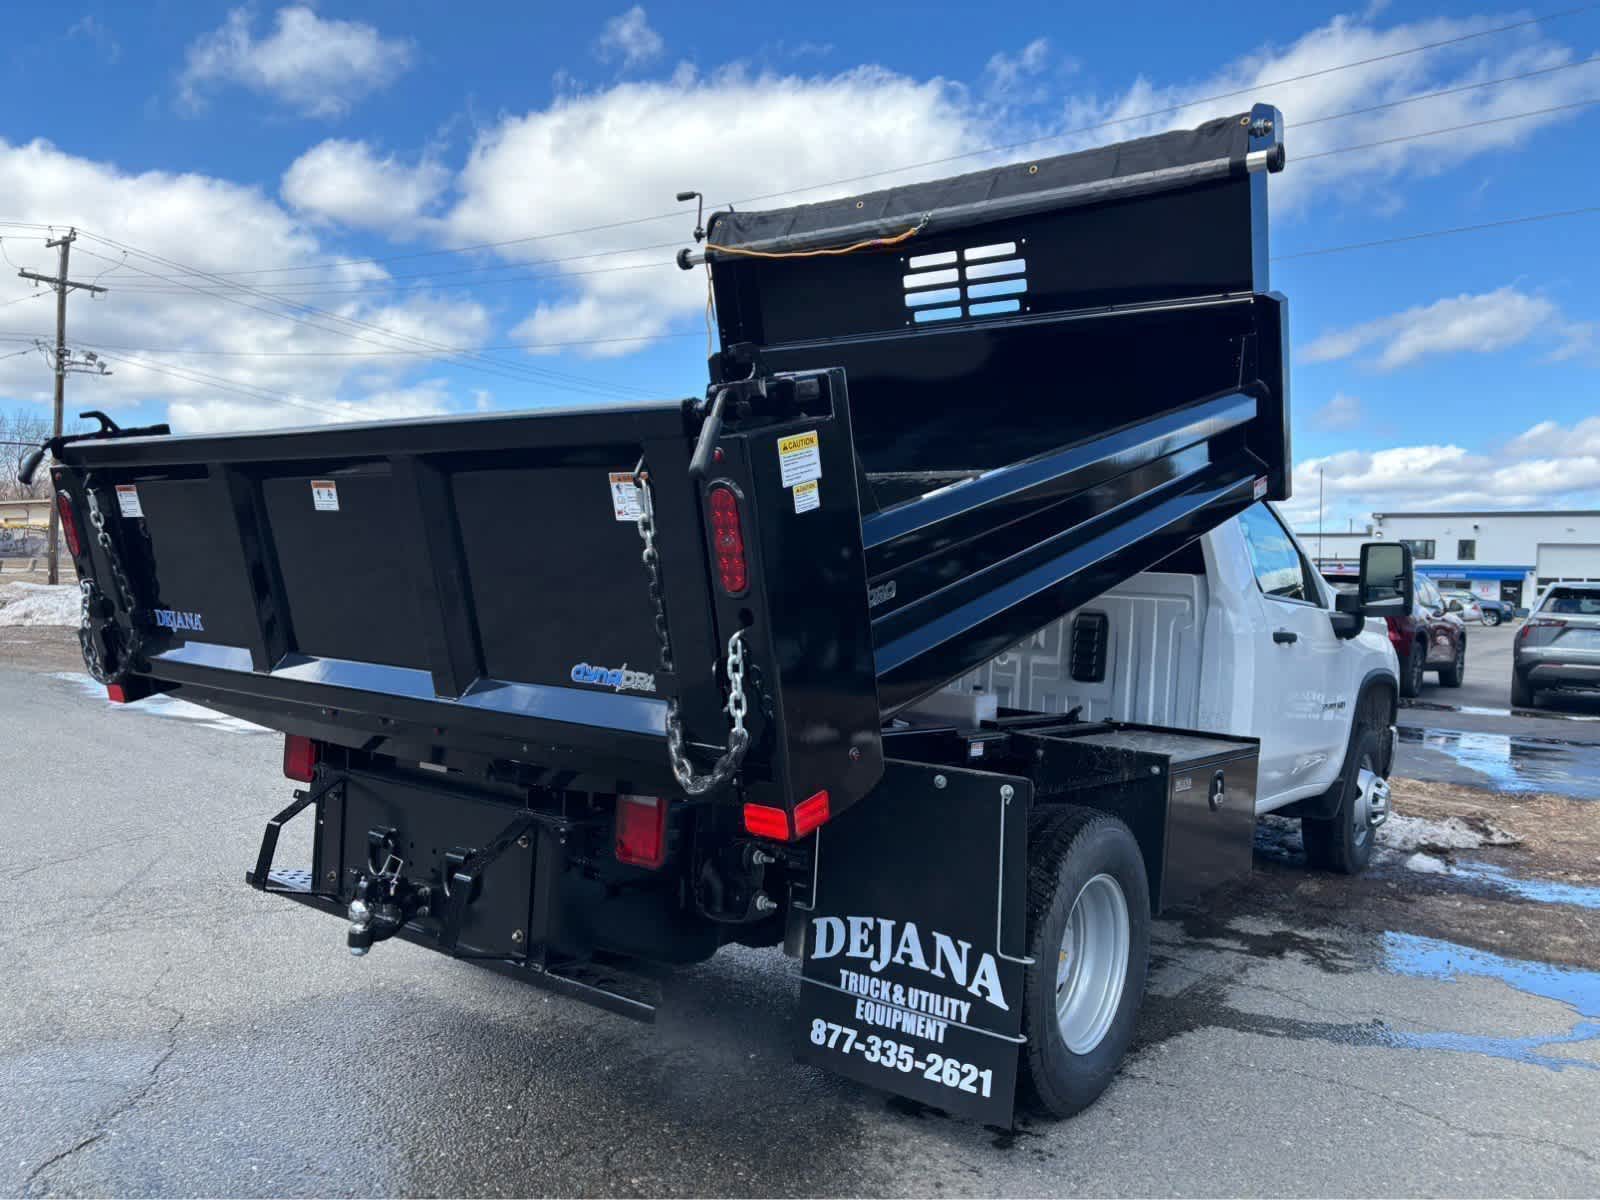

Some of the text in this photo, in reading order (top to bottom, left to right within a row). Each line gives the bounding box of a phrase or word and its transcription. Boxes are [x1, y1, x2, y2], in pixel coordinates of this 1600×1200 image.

[788, 437, 815, 450] CAUTION
[153, 609, 204, 633] DEJANA
[810, 915, 1010, 1012] DEJANA
[839, 968, 972, 1024] TRUCK & UTILITY
[855, 999, 948, 1044] EQUIPMENT
[809, 1018, 993, 1098] 877-335-2621
